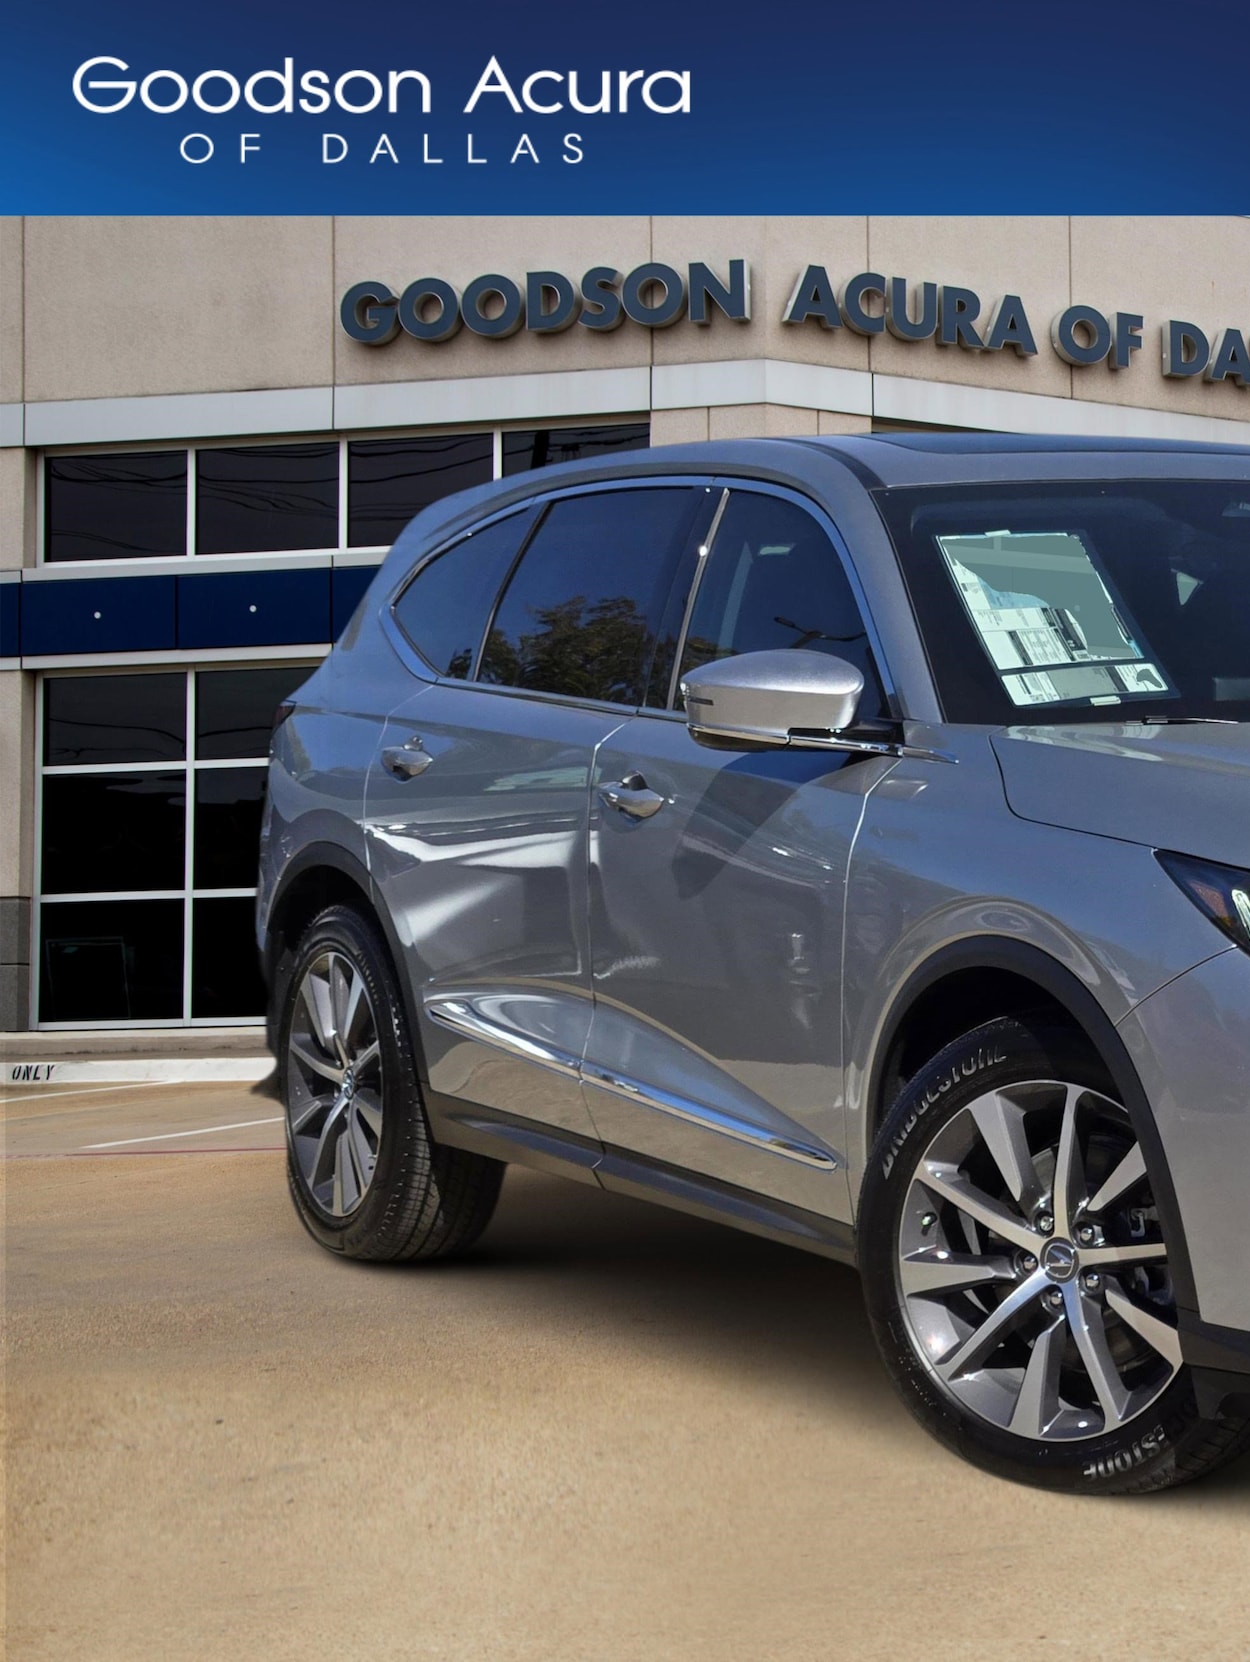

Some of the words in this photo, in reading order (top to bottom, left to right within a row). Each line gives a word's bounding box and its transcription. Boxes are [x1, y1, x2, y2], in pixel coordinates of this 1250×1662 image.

[340, 258, 752, 346] GOODSON
[782, 264, 1038, 358] ACURA
[1050, 304, 1144, 370] OF
[11, 1064, 55, 1082] ONLY
